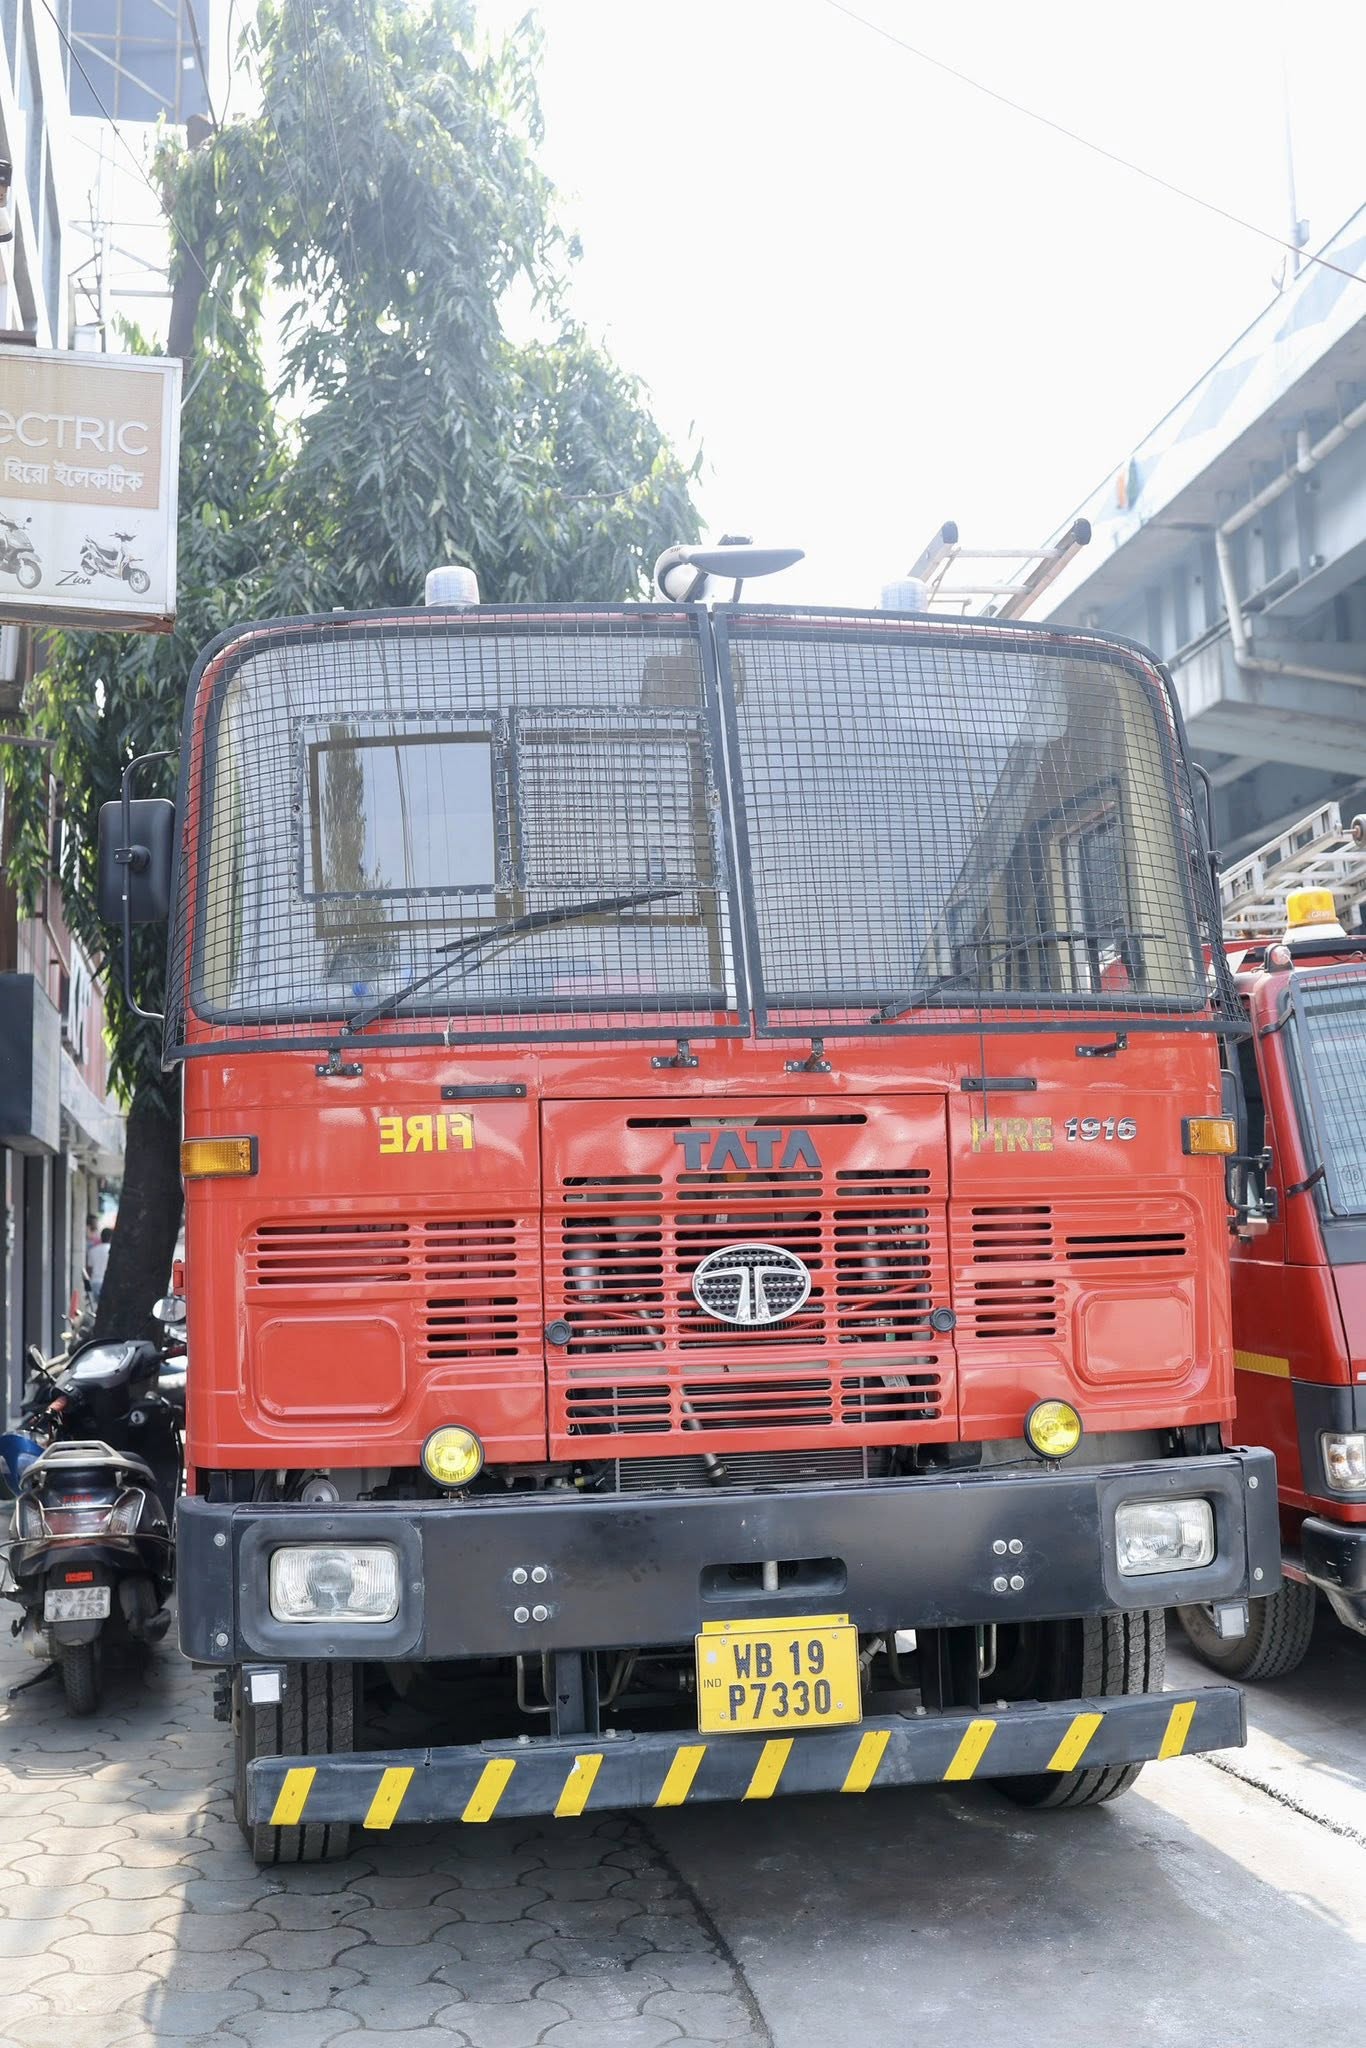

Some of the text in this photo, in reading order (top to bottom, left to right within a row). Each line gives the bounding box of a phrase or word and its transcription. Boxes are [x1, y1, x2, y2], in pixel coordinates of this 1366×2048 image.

[55, 570, 94, 586] Zion
[674, 1130, 822, 1170] TATA
[971, 1116, 1137, 1153] FIRE 1916
[733, 1639, 825, 1679] WB 19
[703, 1678, 722, 1688] IND
[728, 1679, 831, 1721] P7330
